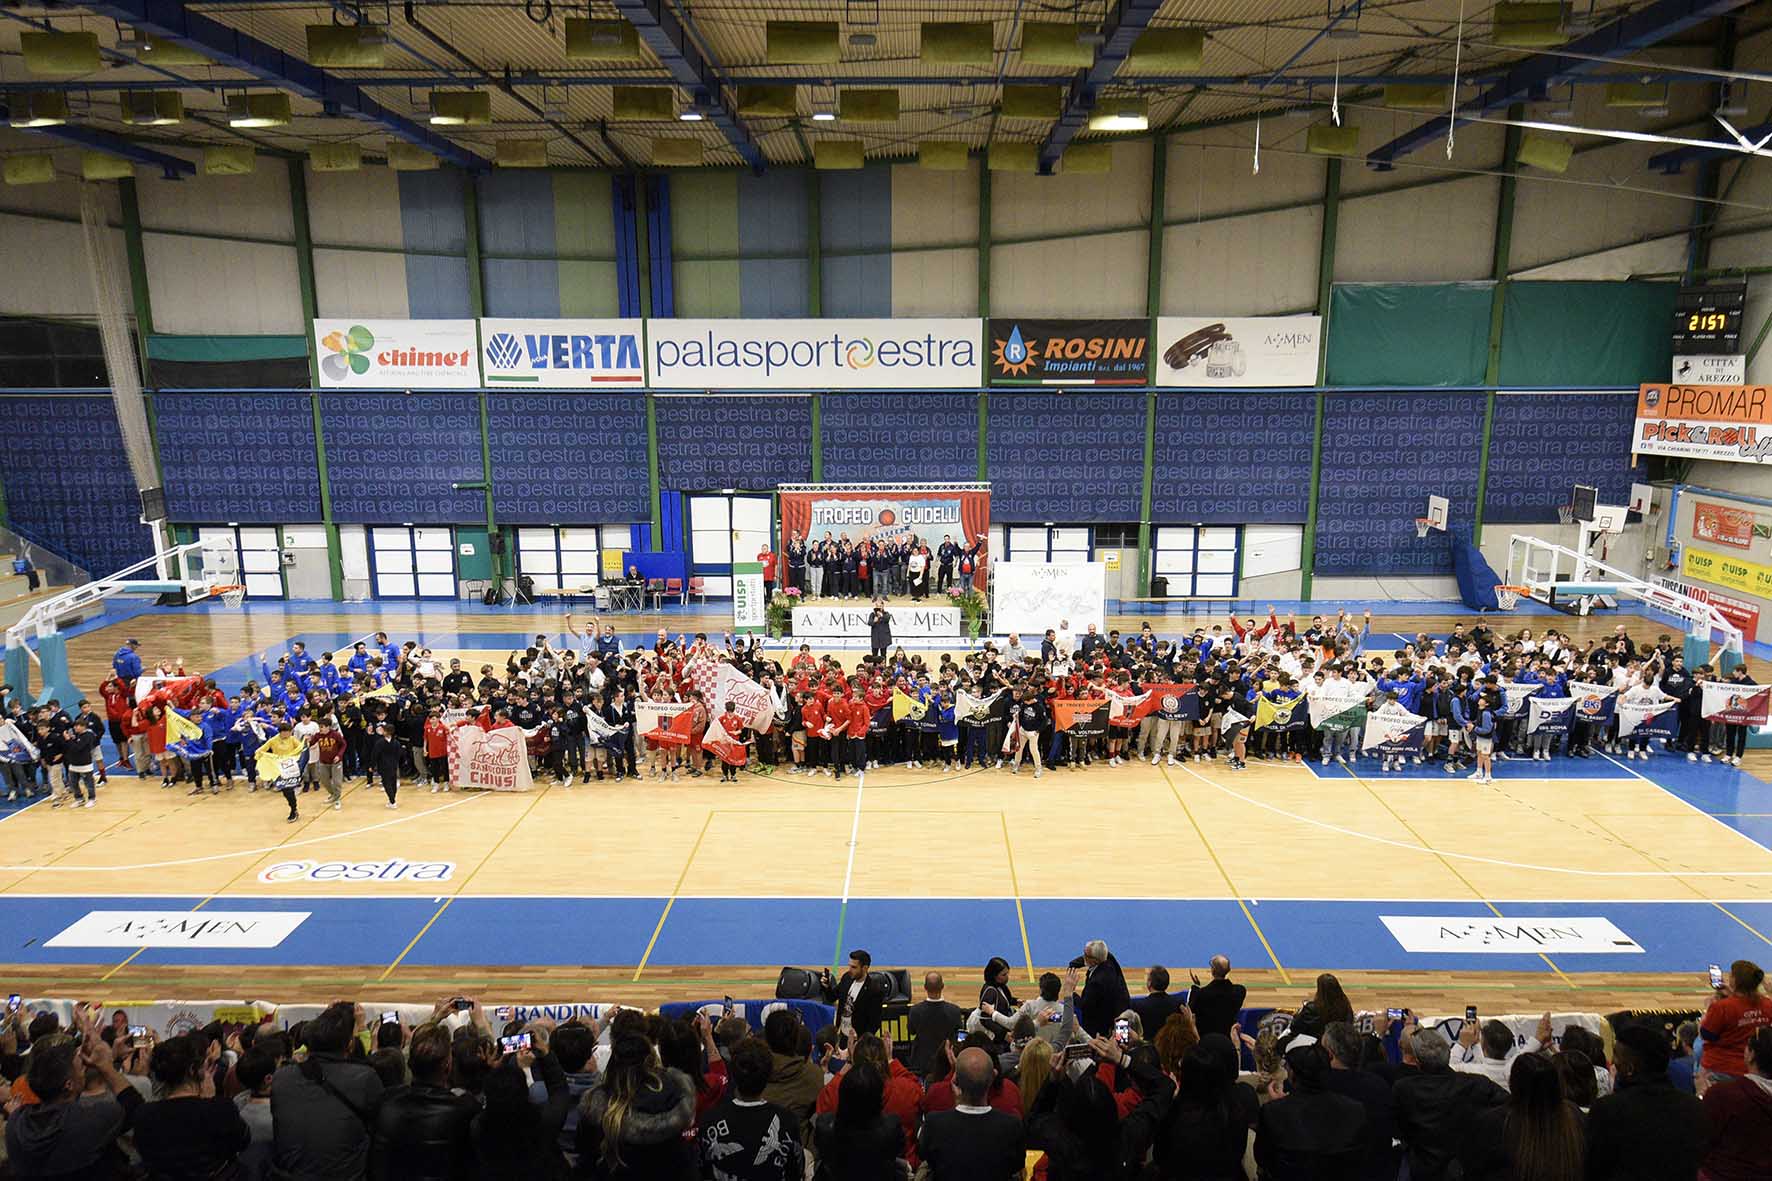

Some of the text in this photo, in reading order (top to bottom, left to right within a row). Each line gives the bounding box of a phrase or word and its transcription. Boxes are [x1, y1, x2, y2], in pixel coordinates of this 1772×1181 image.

[378, 347, 469, 366] chimet
[523, 335, 641, 369] VERTA
[1009, 345, 1021, 359] R
[1043, 337, 1146, 359] ROSINI
[1043, 360, 1097, 373] Impianti
[1113, 363, 1126, 372] dal
[1698, 374, 1740, 383] AREZZO
[1665, 386, 1767, 420] PROMAR
[813, 507, 960, 525] TROFEO GUIDELLI
[1694, 556, 1713, 568] UISP
[1729, 564, 1748, 577] UISP
[737, 579, 746, 608] UISP
[470, 771, 517, 788] CHIUSI
[312, 860, 453, 880] estra
